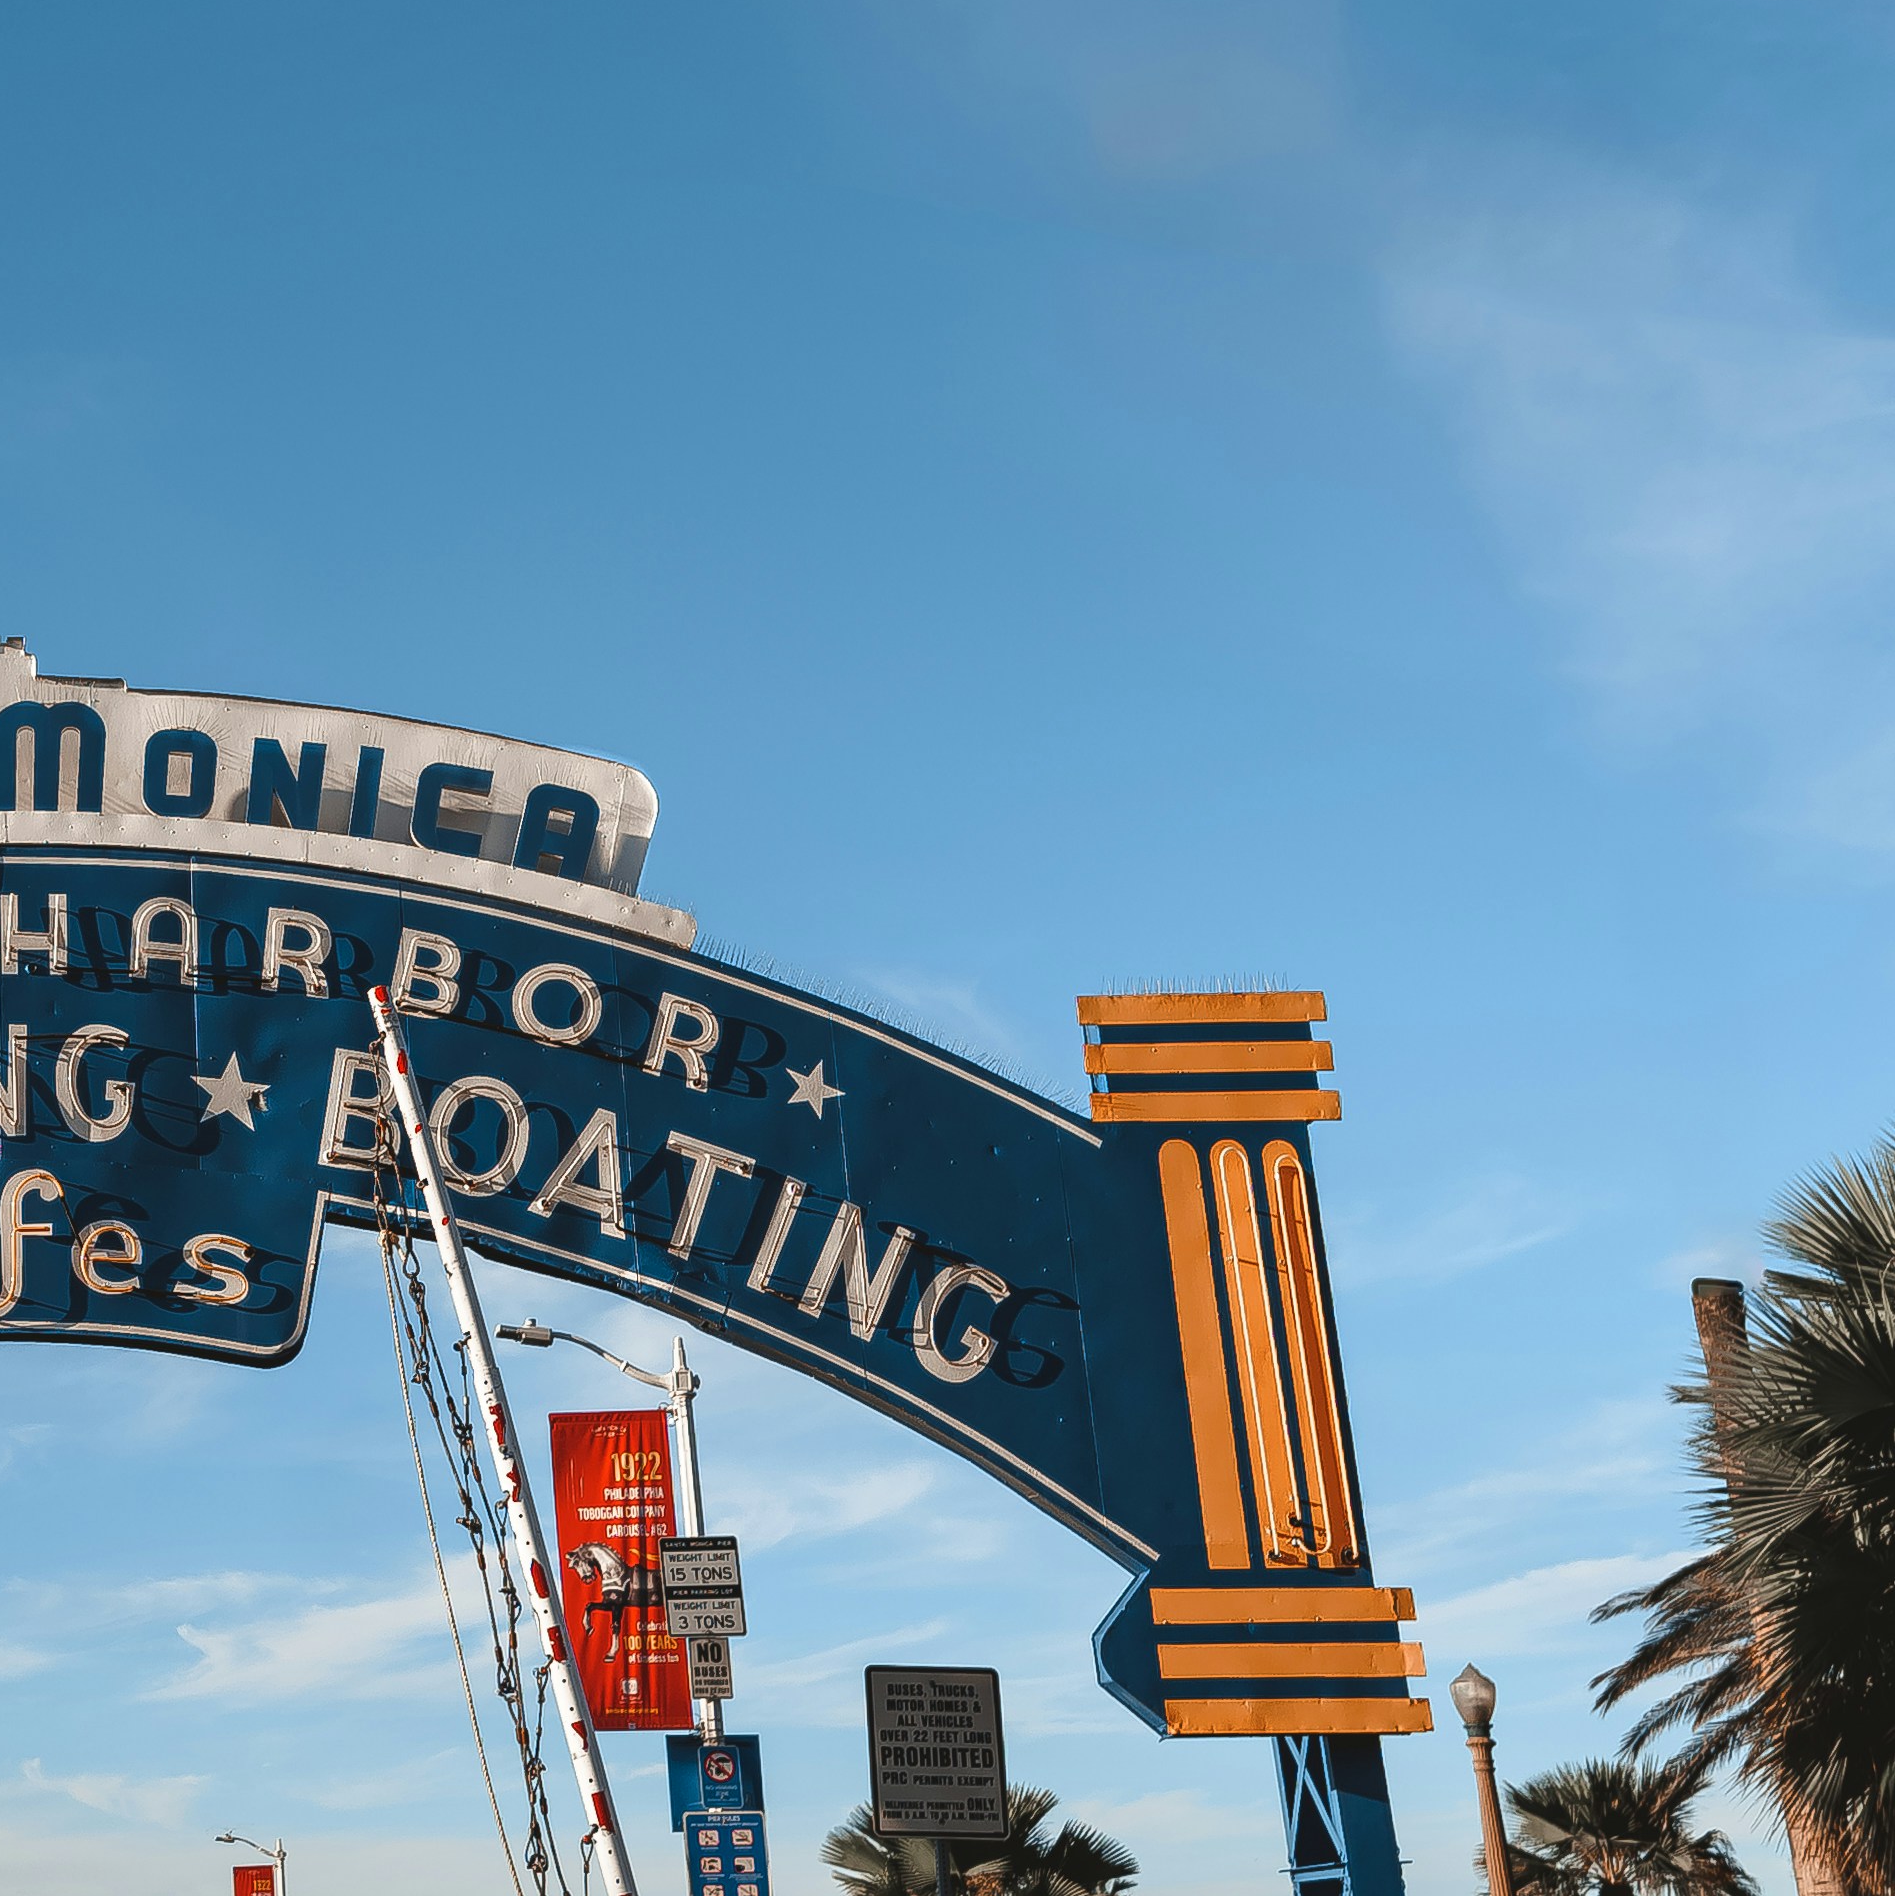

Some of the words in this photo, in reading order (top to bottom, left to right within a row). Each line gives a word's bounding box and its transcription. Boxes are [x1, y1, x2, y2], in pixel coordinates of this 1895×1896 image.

[1, 893, 721, 1093] HARBOR
[317, 1048, 1011, 1384] BOATING
[611, 1451, 663, 1481] 1922
[603, 1486, 665, 1502] PHILADELPHIA
[577, 1506, 624, 1521] TOBOGGAN
[625, 1504, 666, 1518] COMPANY
[606, 1523, 650, 1538] CAROUSEL
[668, 1553, 703, 1563] WEIGHT
[707, 1552, 731, 1562] LIMIT
[669, 1567, 687, 1582] 15
[691, 1566, 733, 1581] TONS
[673, 1601, 708, 1611] WEIGHT
[712, 1600, 736, 1610] LIMIT
[678, 1615, 689, 1630] 3
[694, 1614, 736, 1630] TONS
[623, 1635, 642, 1651] 100
[646, 1634, 678, 1650] YEARS
[696, 1641, 723, 1664] NO
[694, 1666, 728, 1678] BUSES
[887, 1683, 927, 1698] BUSES,
[932, 1684, 979, 1699] TRUCKS,
[886, 1698, 925, 1712] MOTOR
[929, 1700, 969, 1713] HOMES
[972, 1700, 982, 1714] &
[896, 1714, 918, 1727] ALL
[920, 1715, 974, 1728] VEHICLES
[879, 1729, 909, 1743] OVER
[913, 1730, 929, 1743] 22
[933, 1731, 960, 1743] FEET
[963, 1731, 992, 1745] LONG
[880, 1746, 994, 1768] PROHIBITED
[882, 1771, 908, 1785] PRC
[912, 1775, 954, 1786] PERMITS
[956, 1776, 995, 1787] EXEMPT
[966, 1797, 995, 1811] ONLY
